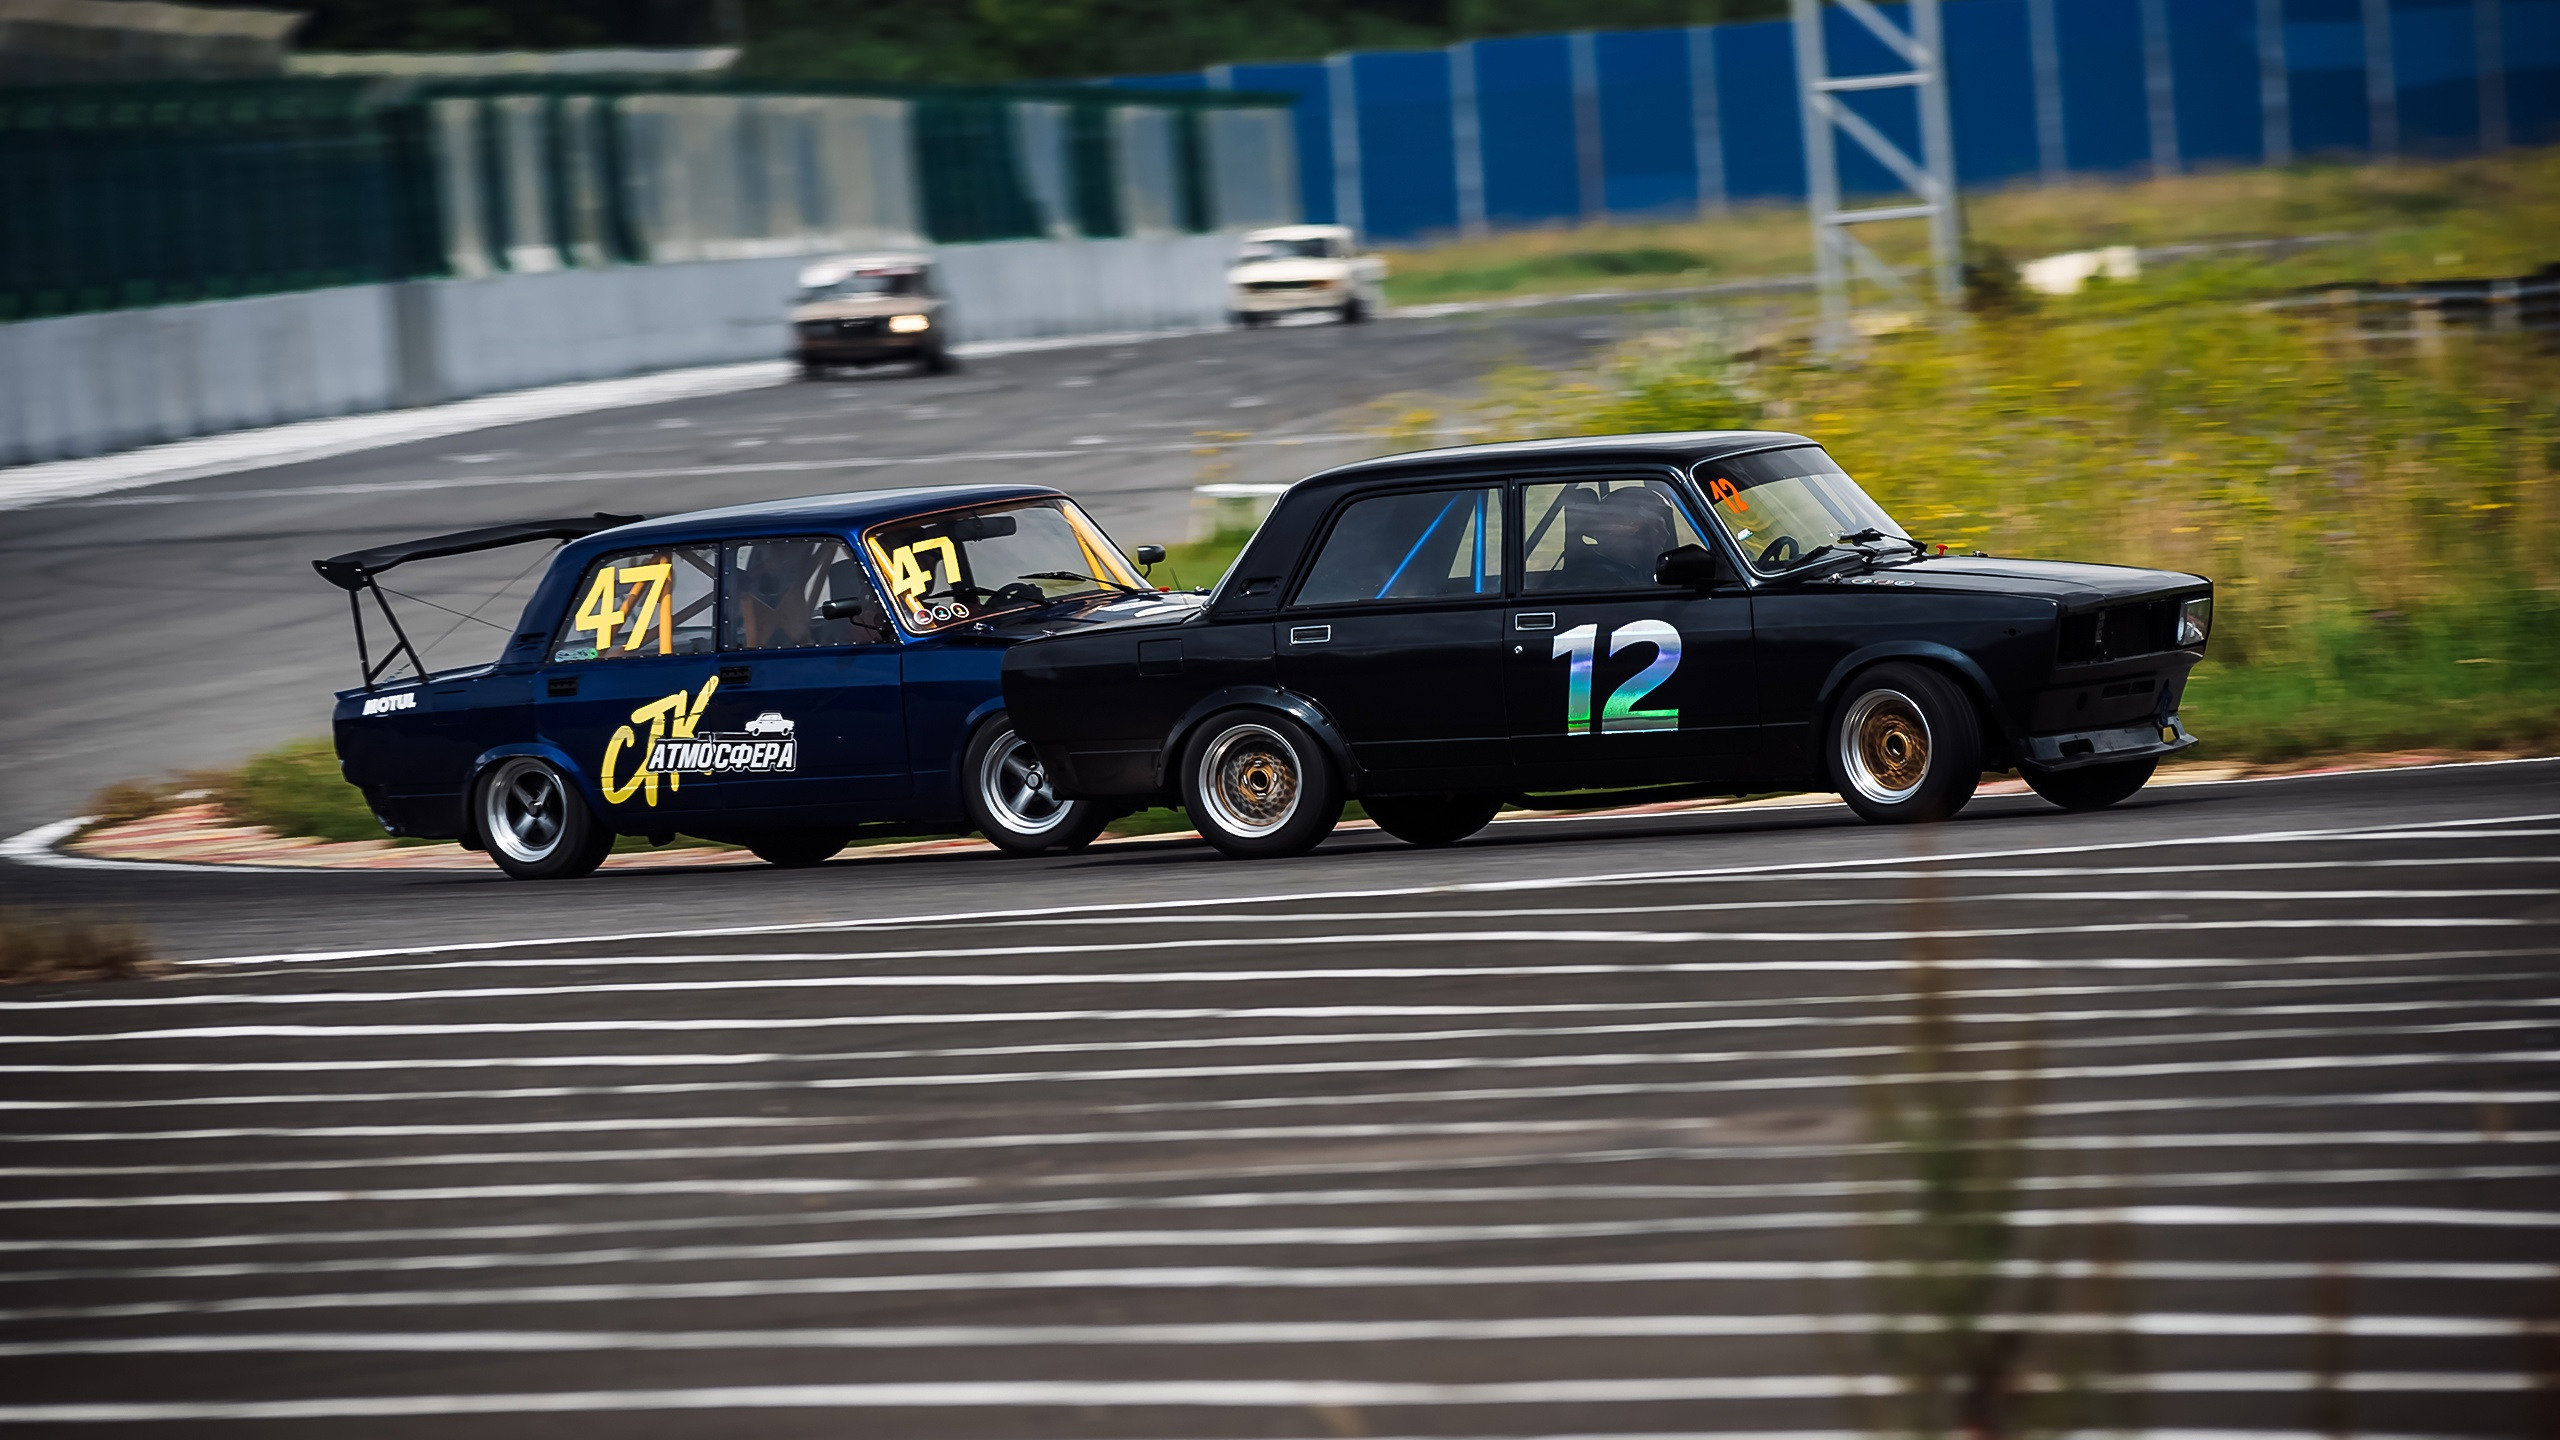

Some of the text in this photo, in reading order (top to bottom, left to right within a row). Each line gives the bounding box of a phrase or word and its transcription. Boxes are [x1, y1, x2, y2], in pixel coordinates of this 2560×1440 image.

[1709, 477, 1749, 515] 12
[892, 535, 962, 598] 47
[575, 563, 672, 651] 47
[1552, 619, 1682, 736] 12
[361, 692, 417, 716] MOTUL
[648, 742, 795, 770] АТМОСФЕРА
